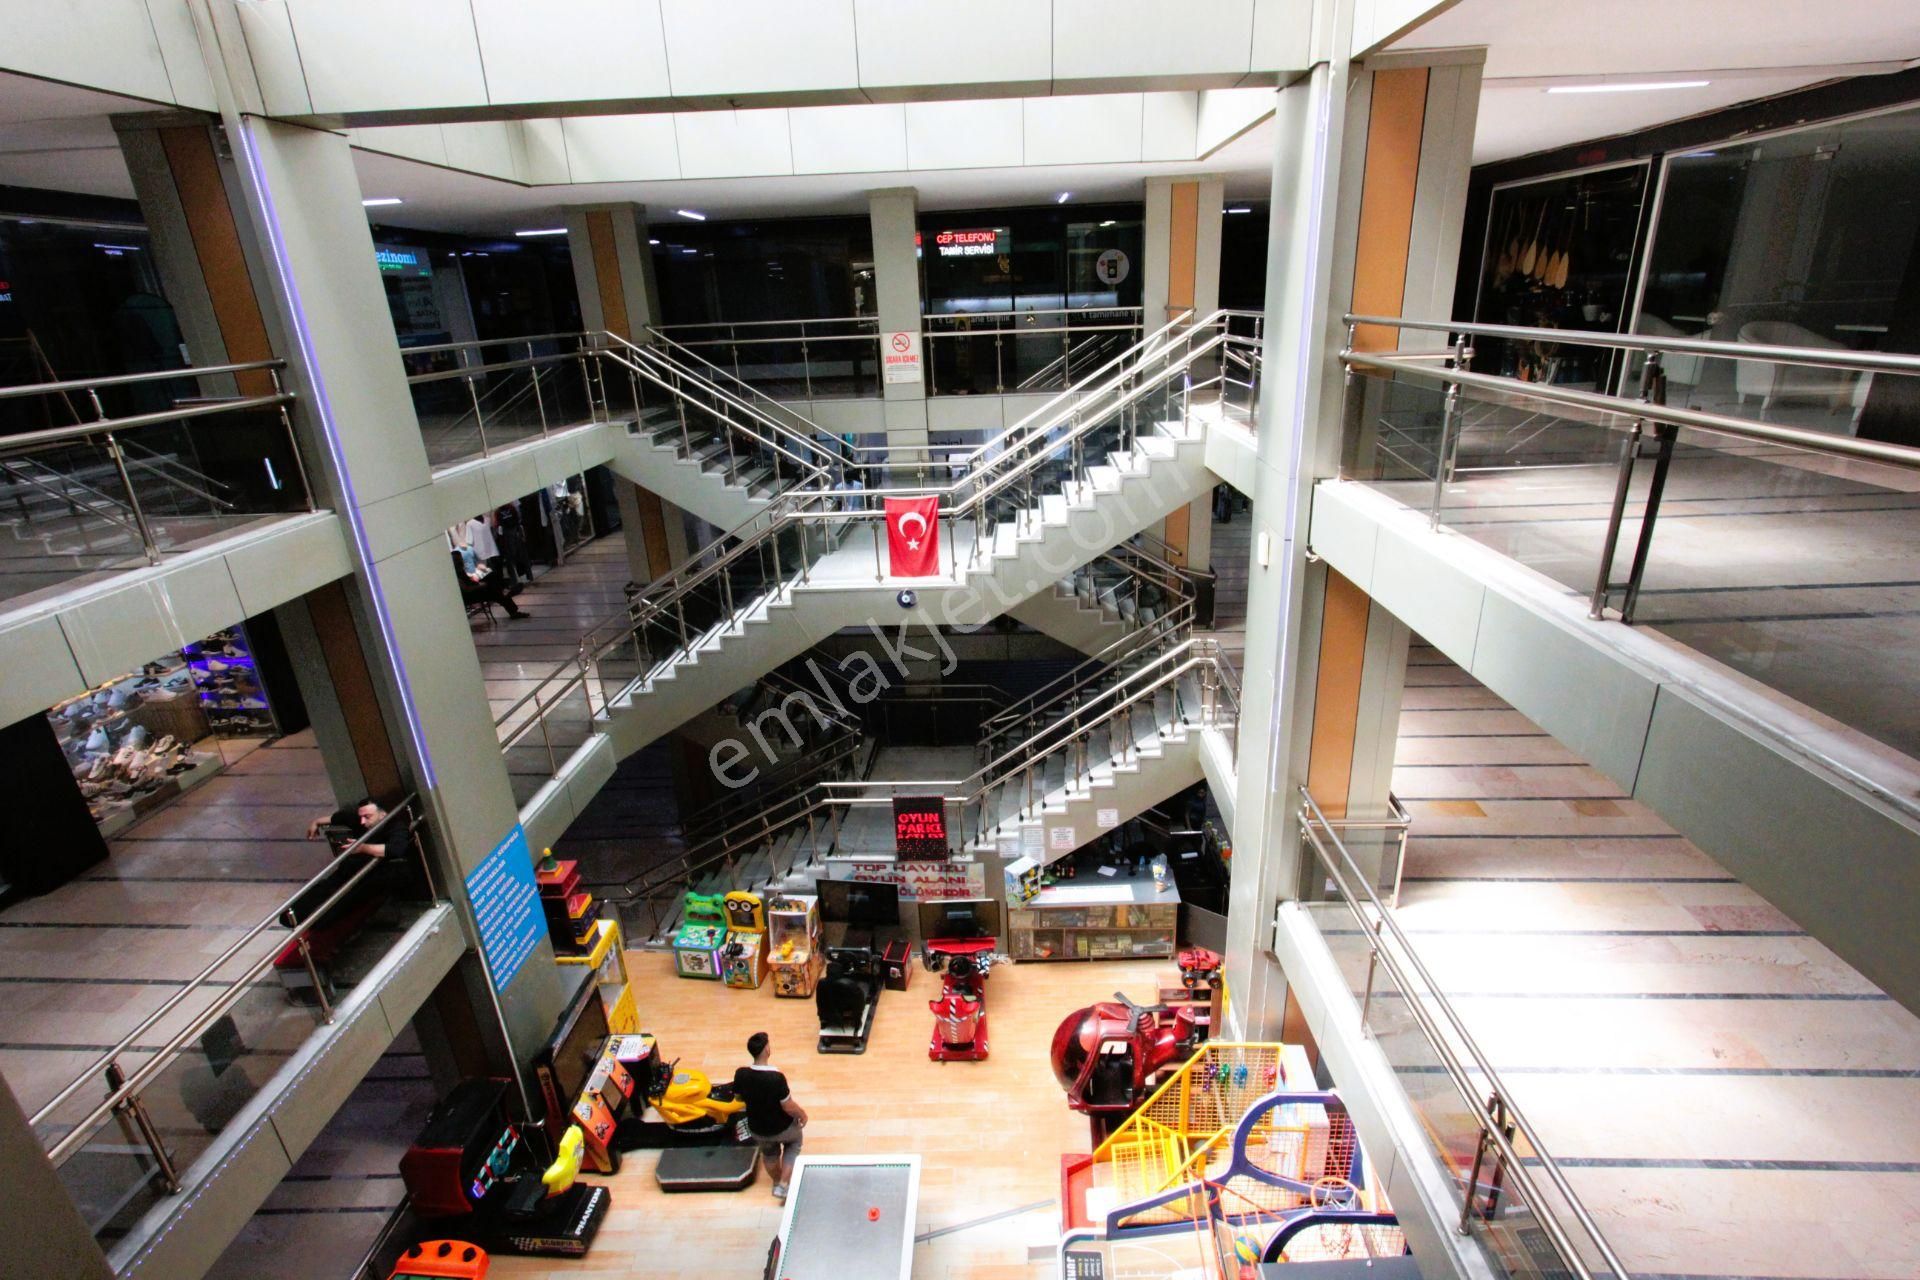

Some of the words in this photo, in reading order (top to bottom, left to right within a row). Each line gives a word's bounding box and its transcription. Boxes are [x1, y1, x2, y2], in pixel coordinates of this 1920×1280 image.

[936, 234, 953, 243] CEP
[954, 232, 995, 242] TELEFONU
[898, 813, 939, 823] OYUN
[898, 823, 942, 833] PARKI
[893, 864, 966, 872] HAVUZU
[575, 1187, 602, 1236] PHANTOM
